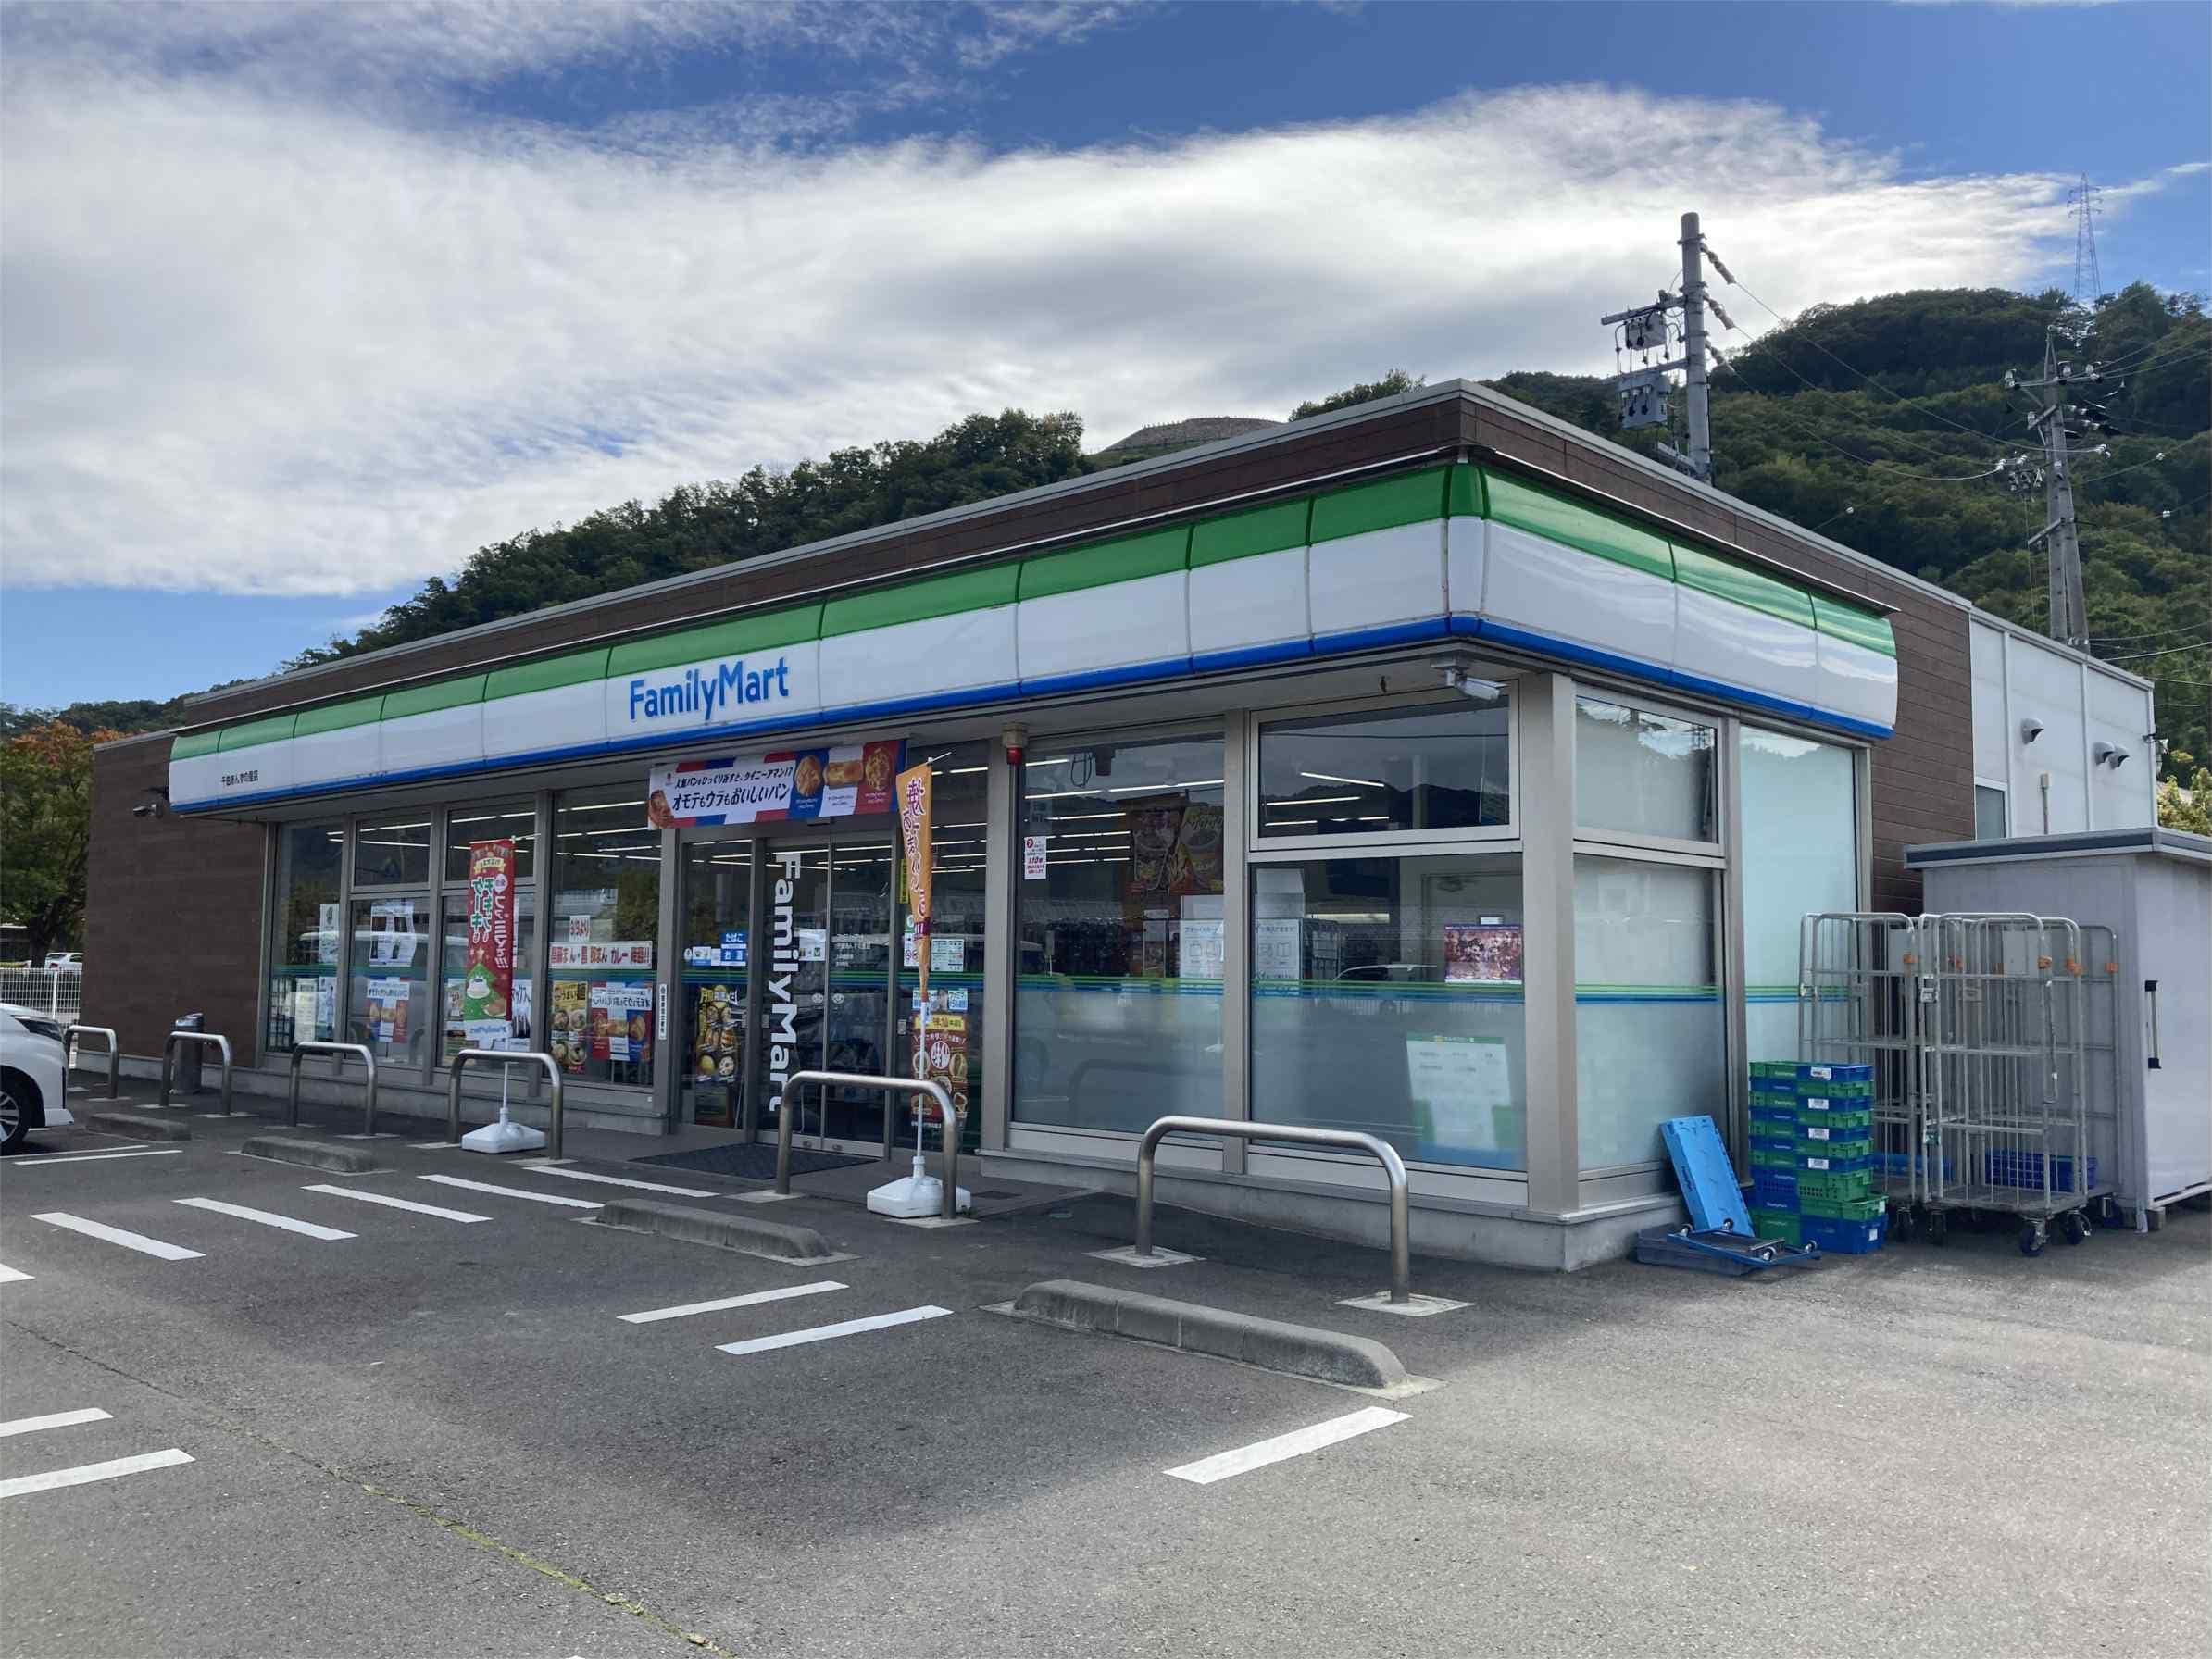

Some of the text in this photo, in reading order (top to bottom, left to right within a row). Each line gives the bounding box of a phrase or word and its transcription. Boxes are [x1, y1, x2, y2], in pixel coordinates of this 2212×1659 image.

[630, 656, 789, 720] FamilyMart
[672, 783, 789, 811] オモテもウラもおいしいパン
[725, 933, 744, 943] たばこ
